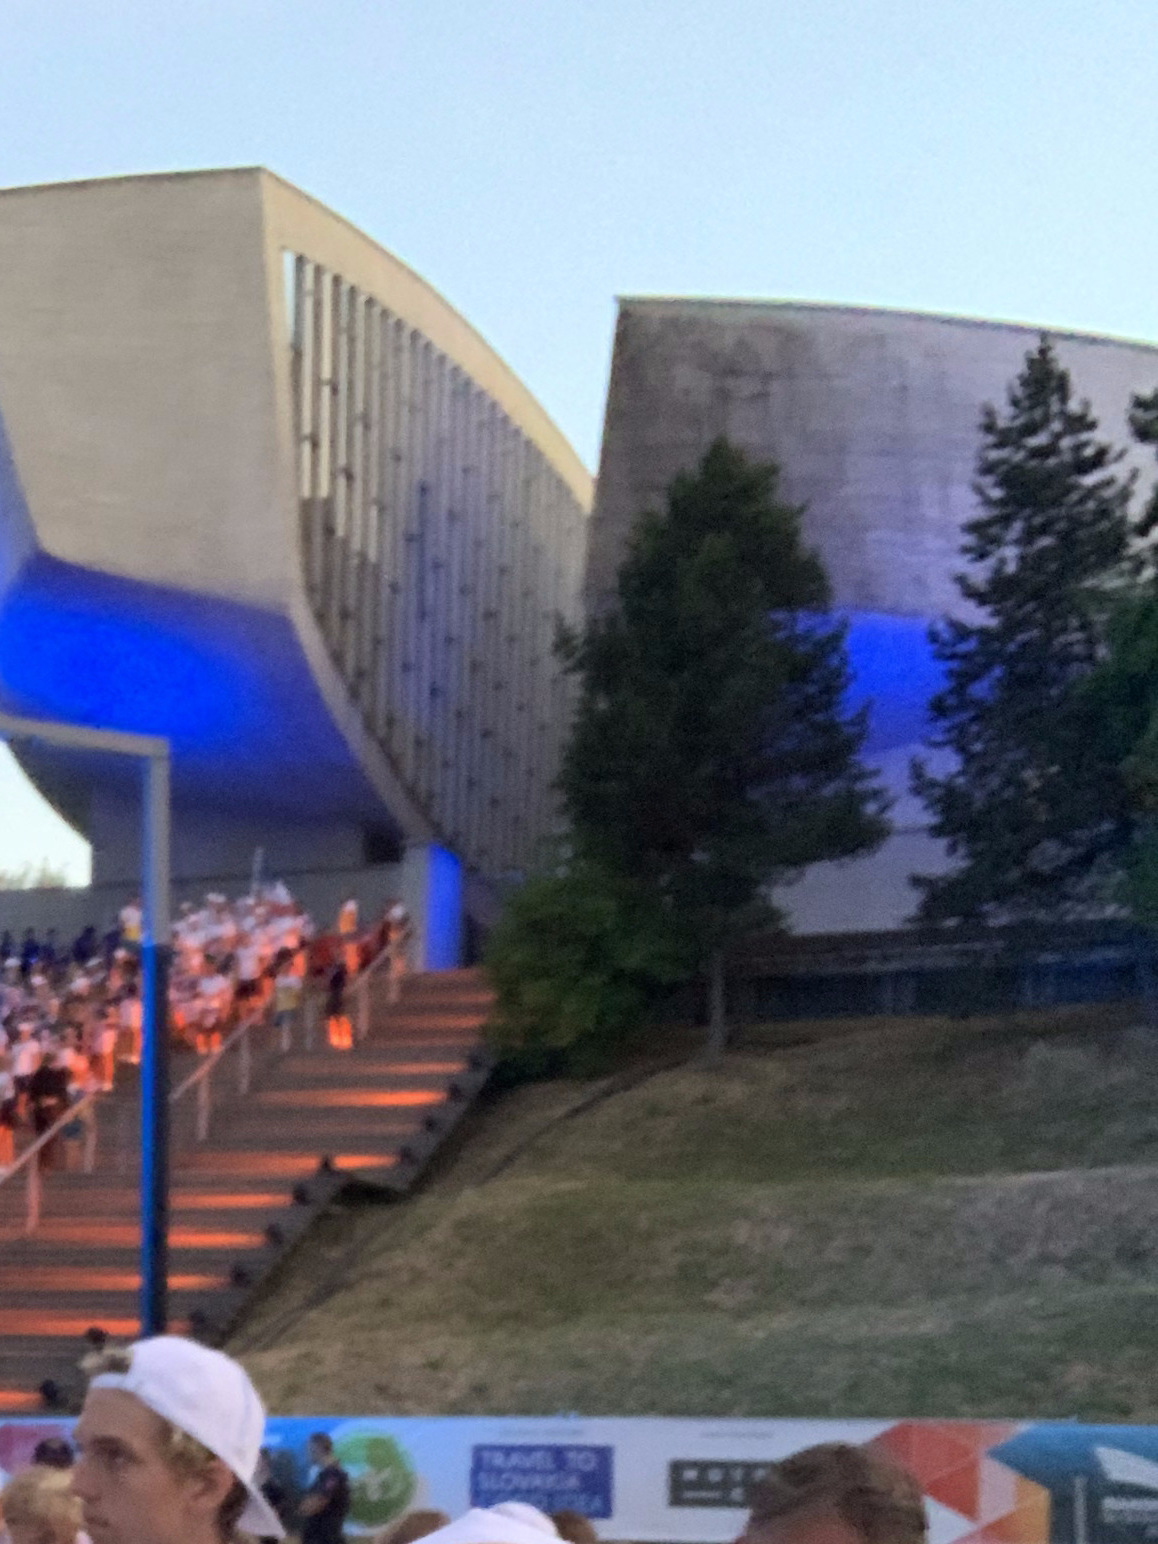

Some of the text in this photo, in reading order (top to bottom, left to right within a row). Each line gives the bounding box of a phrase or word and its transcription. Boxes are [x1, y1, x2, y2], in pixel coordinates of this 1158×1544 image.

[481, 1451, 598, 1471] TRAVEL TO
[478, 1472, 581, 1490] SLOVAKIA
